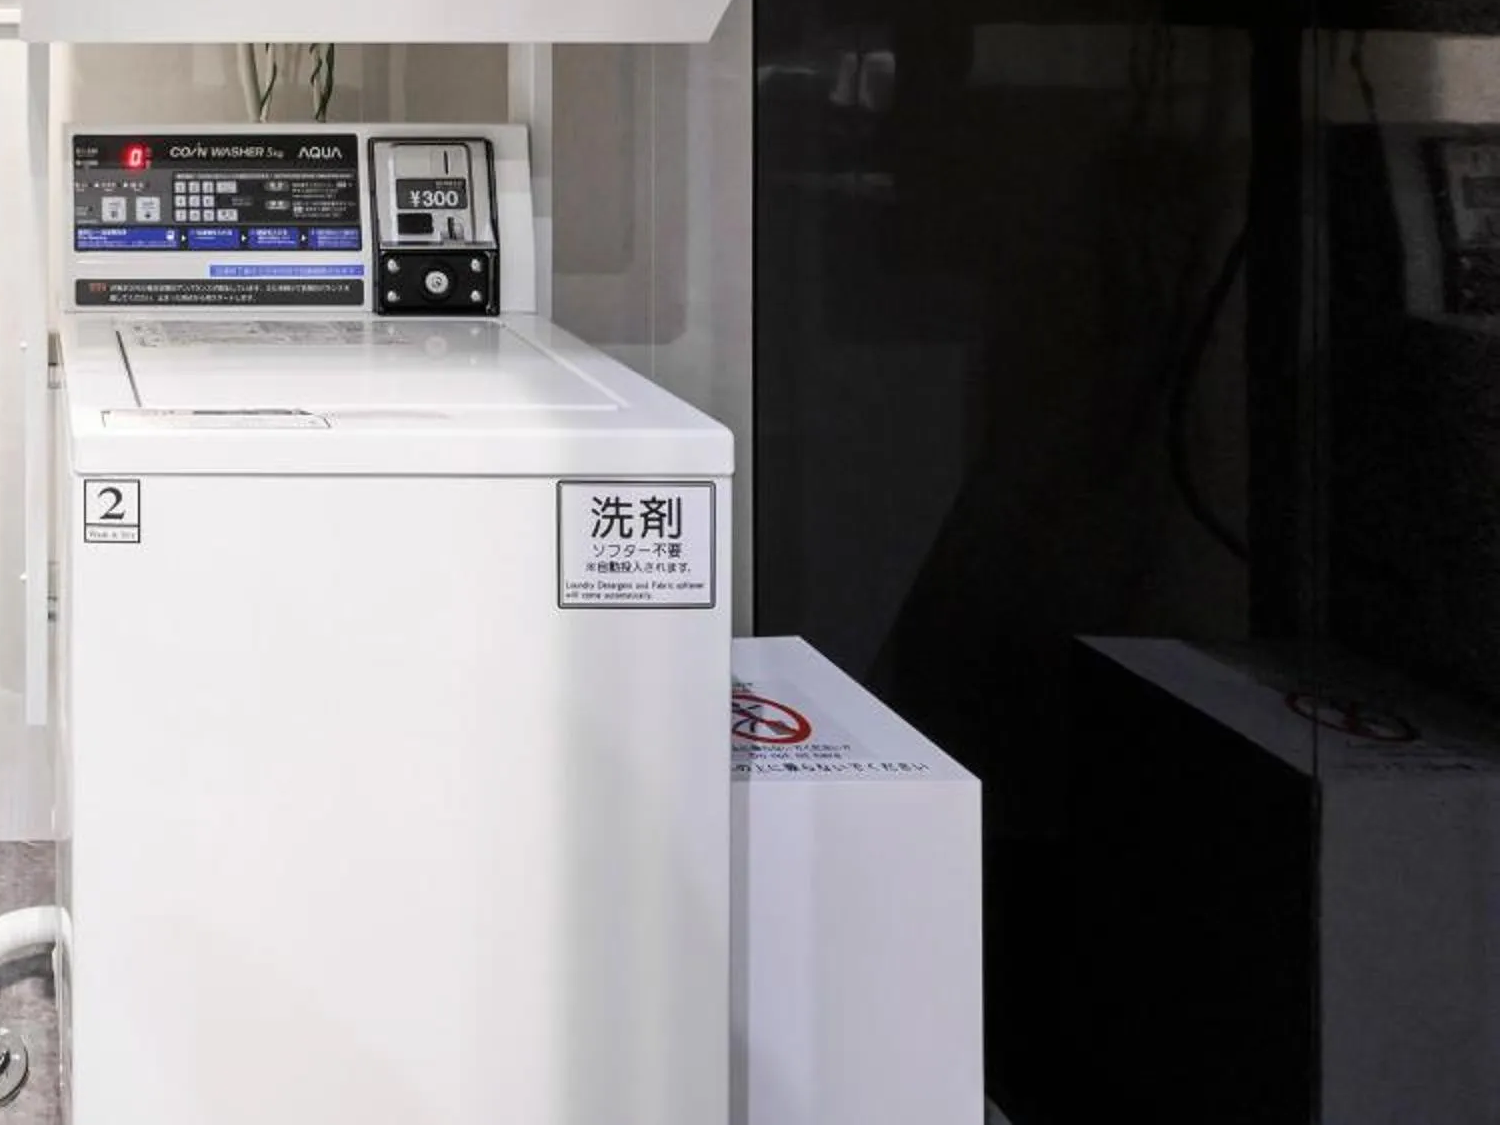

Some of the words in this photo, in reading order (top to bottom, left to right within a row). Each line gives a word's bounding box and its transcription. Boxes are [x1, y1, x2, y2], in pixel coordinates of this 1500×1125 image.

[211, 146, 264, 158] WASHER
[297, 146, 343, 159] AQUA
[410, 190, 459, 207] ¥300
[97, 485, 126, 521] 2
[590, 495, 682, 540] 洗剤
[592, 542, 683, 558] ソフター不要
